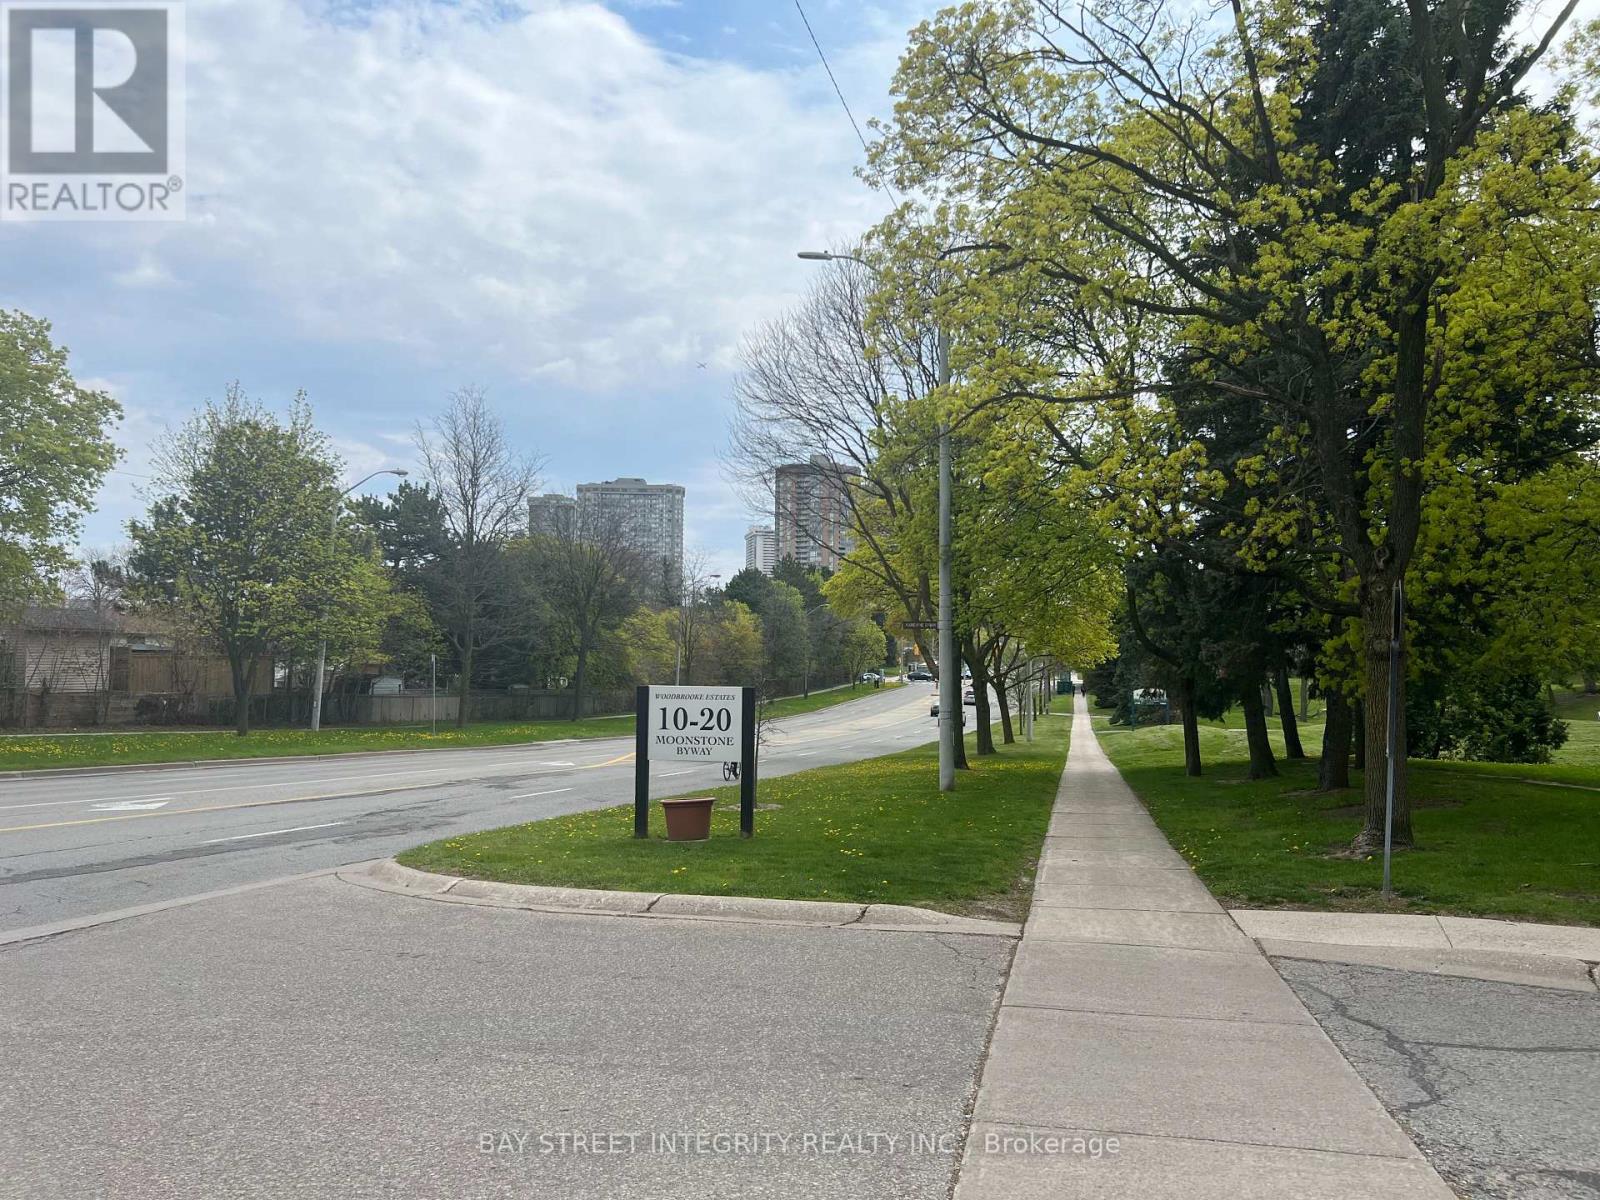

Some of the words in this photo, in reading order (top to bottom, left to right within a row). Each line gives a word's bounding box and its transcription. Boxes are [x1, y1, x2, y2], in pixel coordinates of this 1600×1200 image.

[655, 693, 703, 701] WOODBROOKE
[658, 706, 732, 732] 10-20
[655, 735, 735, 746] MOONSTONE
[676, 746, 713, 756] BYWAY
